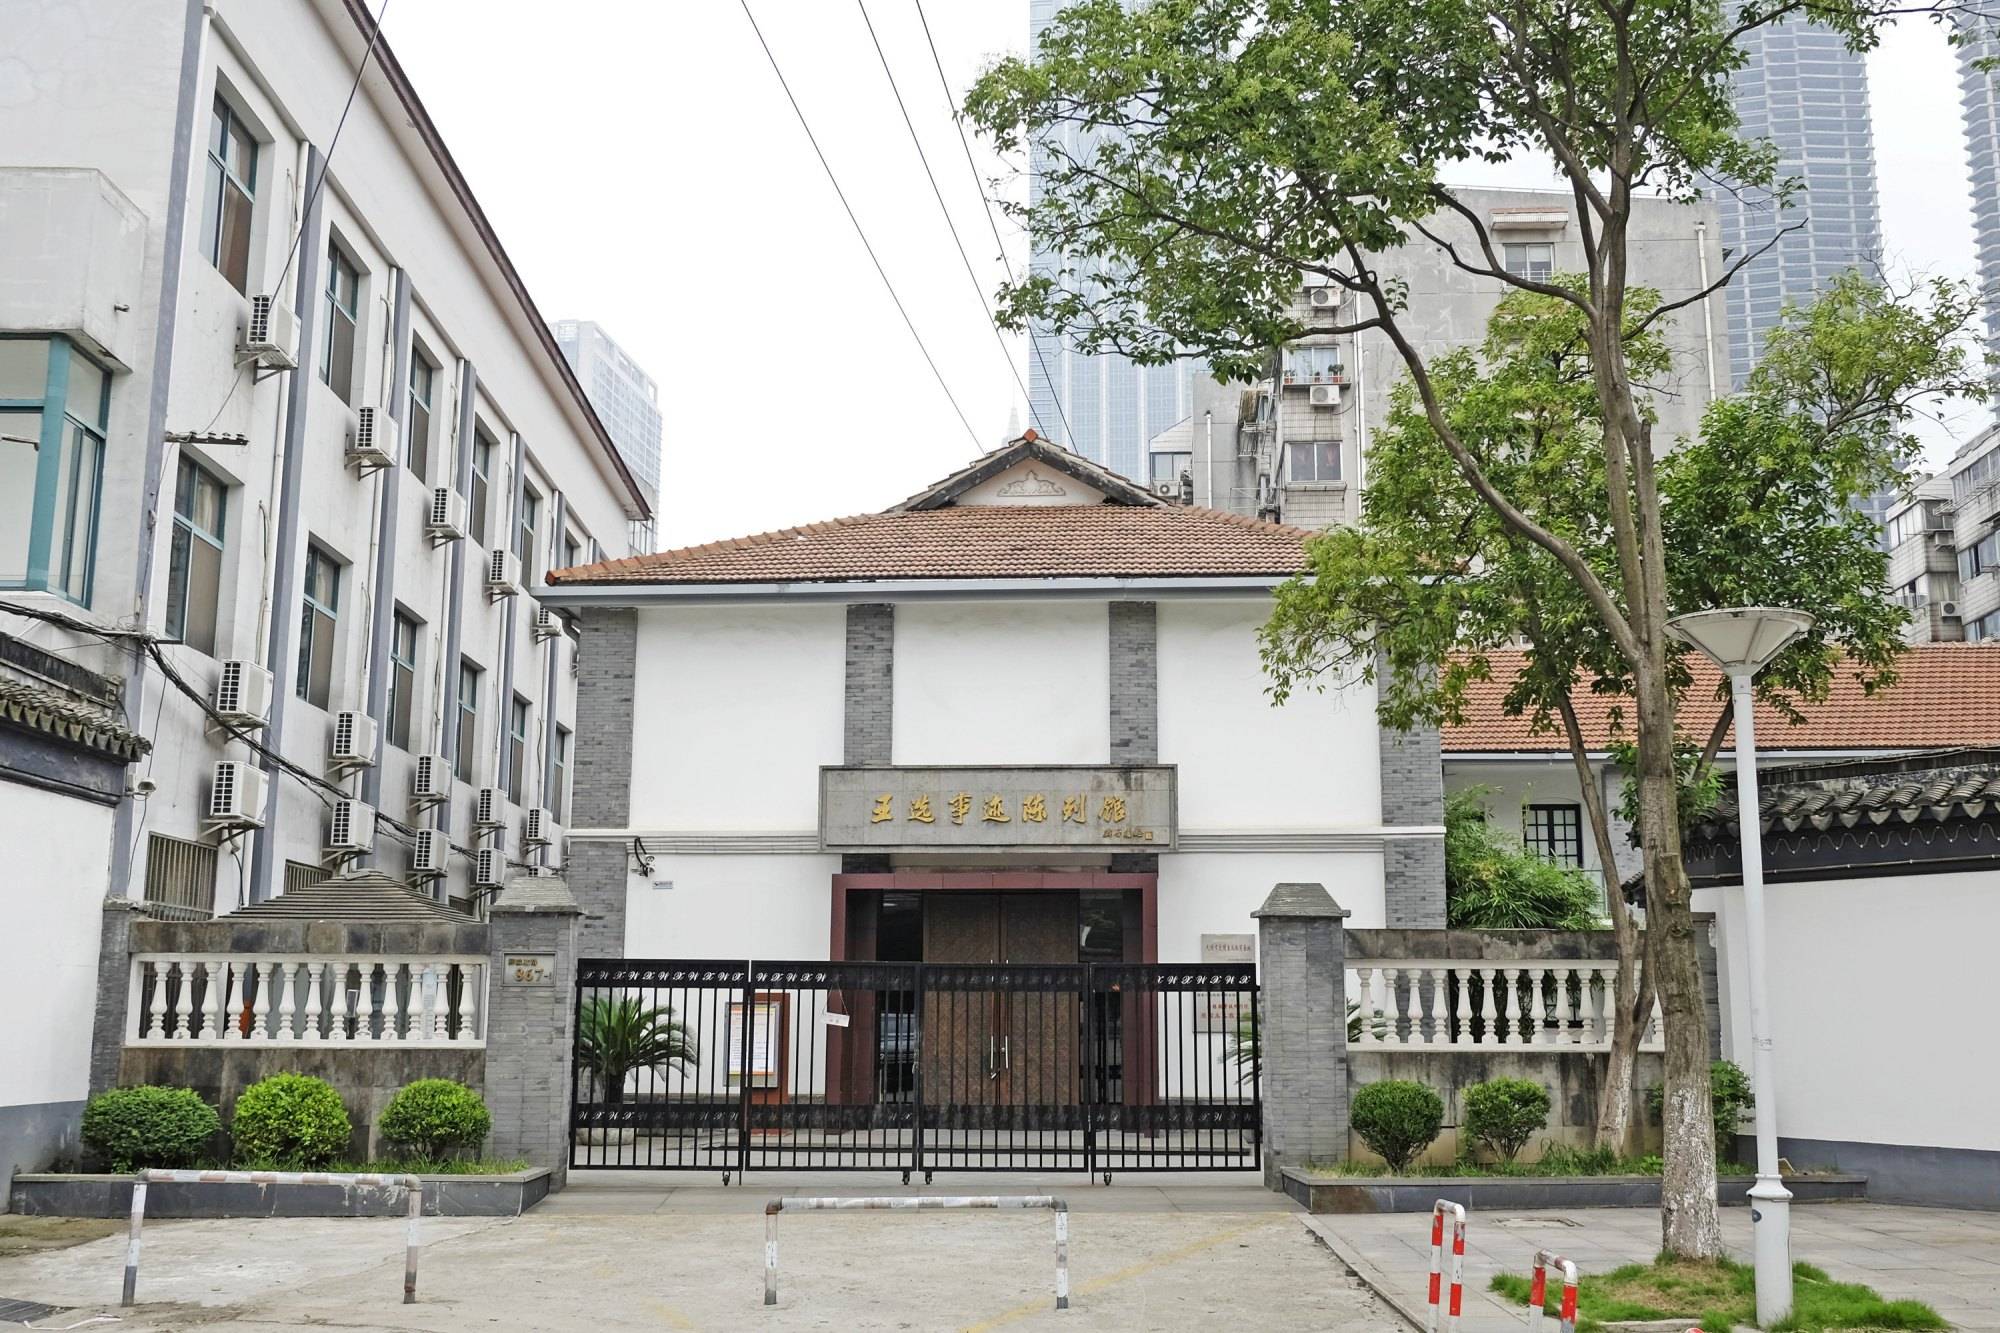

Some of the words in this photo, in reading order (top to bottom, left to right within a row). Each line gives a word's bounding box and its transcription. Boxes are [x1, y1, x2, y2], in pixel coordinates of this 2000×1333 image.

[870, 791, 1128, 825] 王选事迹陈列馆
